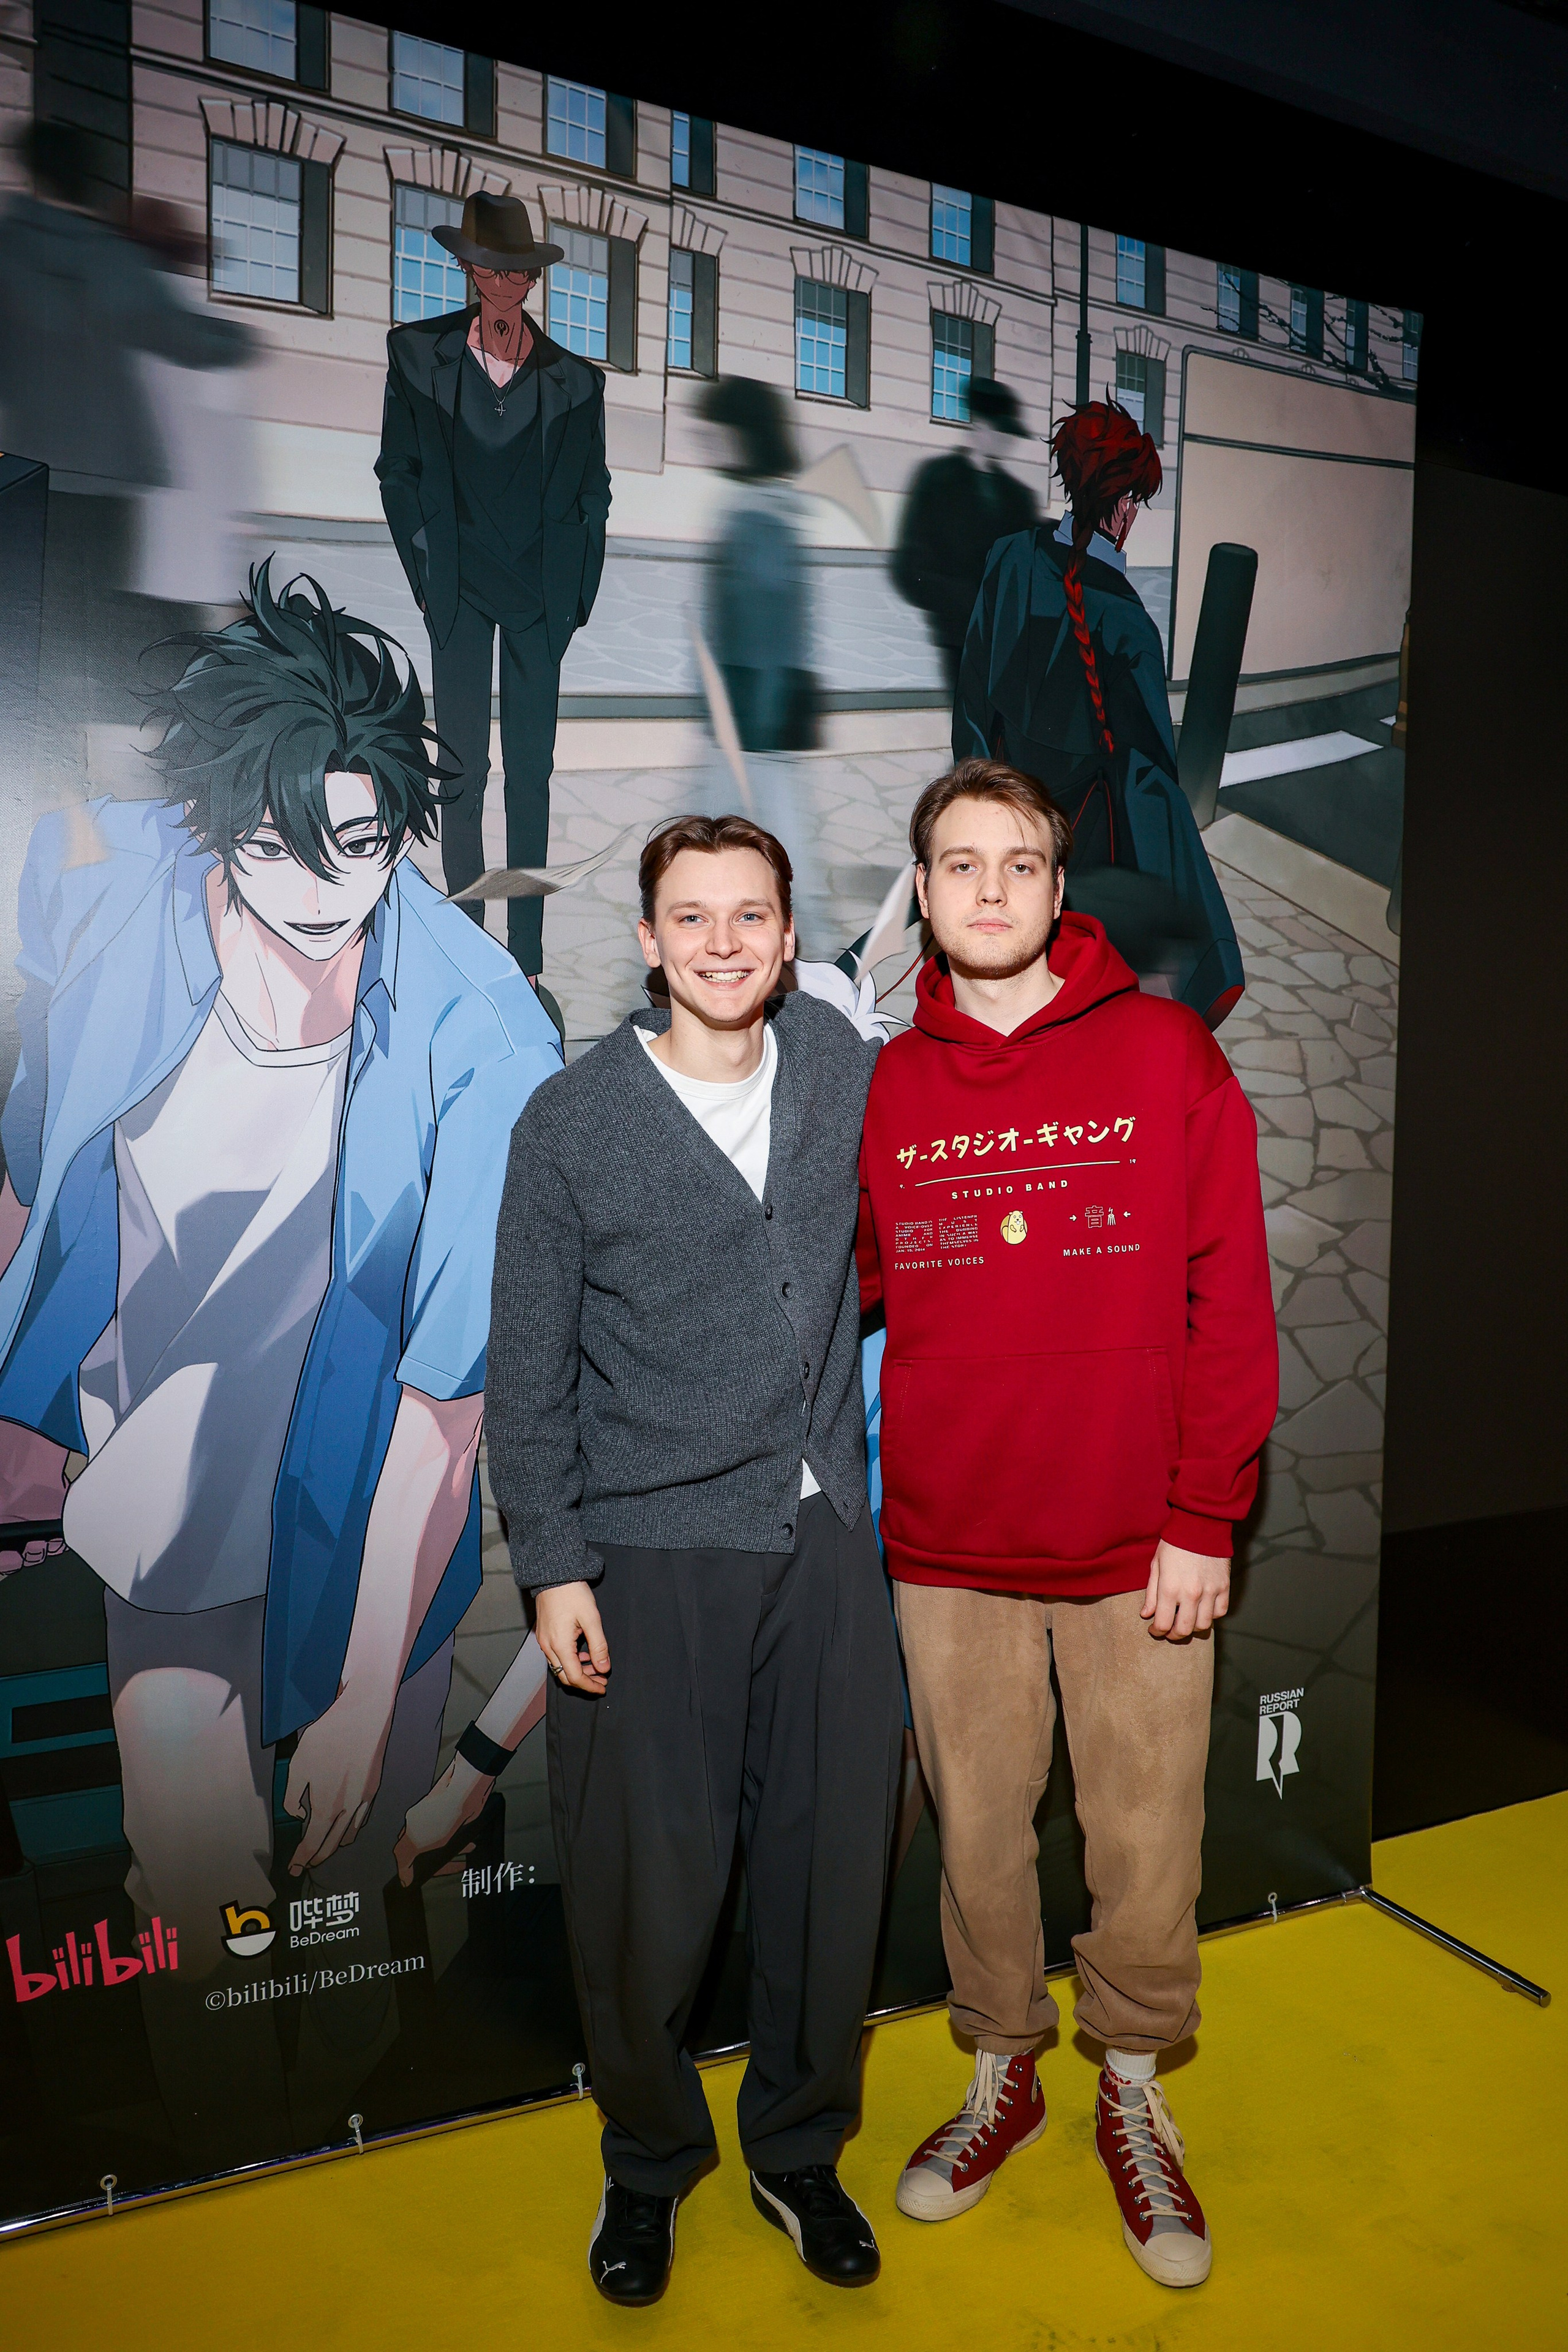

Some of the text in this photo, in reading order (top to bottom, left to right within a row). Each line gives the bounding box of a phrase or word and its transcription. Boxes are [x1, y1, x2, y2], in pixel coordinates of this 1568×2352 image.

[951, 1180, 1068, 1199] STUDIO BAND
[1063, 1247, 1091, 1256] MAKE
[1107, 1243, 1140, 1253] SOUND
[895, 1256, 984, 1270] FAVORITE VOICES
[1259, 1687, 1304, 1705] RUSSIAN
[1259, 1698, 1300, 1715] REPORT
[290, 1926, 360, 1948] BeDream
[6, 1916, 178, 2002] bilibili
